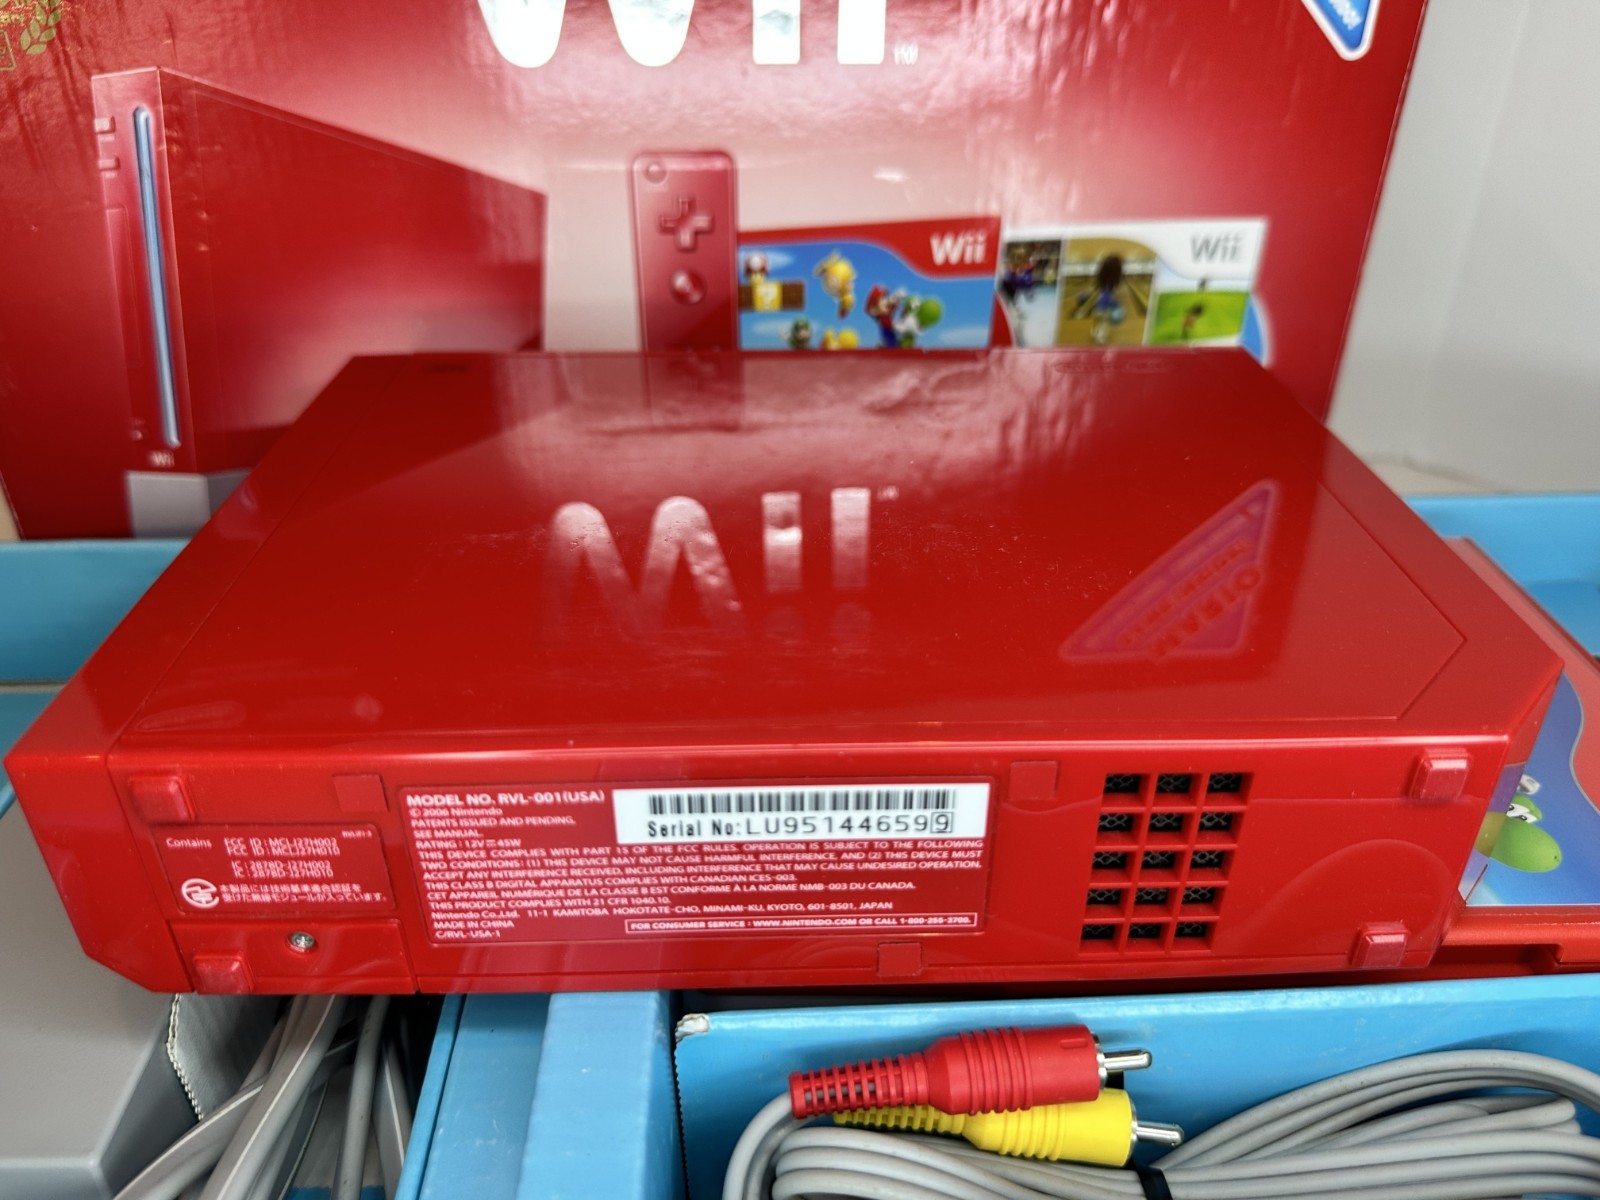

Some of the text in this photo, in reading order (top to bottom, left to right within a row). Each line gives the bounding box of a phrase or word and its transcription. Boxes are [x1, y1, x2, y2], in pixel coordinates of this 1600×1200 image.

[930, 231, 988, 265] Wii
[1190, 233, 1242, 264] Wii
[407, 791, 605, 807] MODEL NO. RVL-001(USA)
[423, 808, 449, 817] 2006
[451, 806, 503, 816] Nintendo
[411, 818, 458, 828] PATENTS
[460, 818, 497, 827] ISSUED
[500, 817, 524, 826] AND
[649, 820, 701, 837] Serial
[414, 829, 432, 838] SEE
[166, 837, 212, 849] Contains
[416, 840, 457, 849] RATING
[465, 840, 484, 848] 12V
[497, 839, 521, 847] 45W
[420, 850, 443, 860] THIS
[447, 850, 487, 859] DEVICE
[491, 849, 546, 858] COMPLIES
[550, 847, 579, 856] WITH
[583, 846, 611, 855] PART
[616, 846, 629, 854] 15
[652, 845, 673, 853] THE
[702, 844, 739, 852] RULES.
[743, 842, 806, 851] OPERATION
[809, 842, 820, 850] IS
[823, 841, 869, 849] SUBJECT
[873, 841, 888, 849] TO
[893, 841, 913, 849] THE
[917, 840, 983, 848] FOLLOWING
[421, 861, 447, 870] TWO
[527, 858, 540, 868] (1)
[544, 858, 567, 867] THIS
[570, 856, 608, 866] DEVICE
[612, 855, 636, 865] MAY
[640, 855, 662, 864] NOT
[666, 854, 701, 863] CAUSE
[704, 853, 756, 862] HARMFUL
[841, 852, 865, 860] AND
[869, 851, 882, 860] (2)
[885, 851, 907, 859] THIS
[911, 850, 948, 858] DEVICE
[952, 850, 983, 858] MUST
[423, 871, 464, 880] ACCEPT
[466, 870, 489, 880] ANY
[492, 868, 568, 878] INTERFERENCE
[625, 866, 685, 875] INCLUDING
[687, 865, 762, 874] INTERFERENCE
[764, 863, 793, 872] THAT
[794, 863, 817, 871] MAY
[820, 862, 855, 871] CAUSE
[857, 862, 916, 870] UNDESIRED
[919, 860, 981, 869] OPERATION.
[425, 873, 797, 890] THIS CLASS B DIGITAL APPARATUS COMPLIES WITH CANADIAN ICES-003.
[427, 891, 447, 901] CET
[449, 890, 499, 900] APPAREIL
[567, 888, 582, 897] DE
[584, 888, 598, 896] LA
[601, 887, 639, 896] CLASSE
[641, 886, 648, 895] B
[650, 886, 668, 895] EST
[671, 885, 731, 894] CONFORME
[733, 882, 742, 892] À
[743, 884, 757, 892] LA
[758, 883, 797, 891] NORME
[800, 882, 847, 891] NMB-003
[850, 882, 866, 890] DU
[868, 881, 916, 889] CANADA.
[430, 896, 671, 910] THIS PRODUCT COMPLIES WITH 21 CFR 1040.10.
[432, 910, 480, 919] Nintendo
[527, 909, 548, 917] 11-1
[553, 907, 609, 917] KAMITOBA
[859, 901, 893, 910] JAPAN
[433, 919, 515, 930] MADE IN CHINA
[631, 922, 650, 930] FOR
[652, 921, 706, 930] CONSUMER
[707, 920, 745, 929] SERVICE
[753, 918, 856, 928] WWW.NINTENDO.COM
[859, 917, 873, 926] OR
[874, 917, 898, 925] CALL
[436, 929, 500, 939] C/RVL-USA-1
